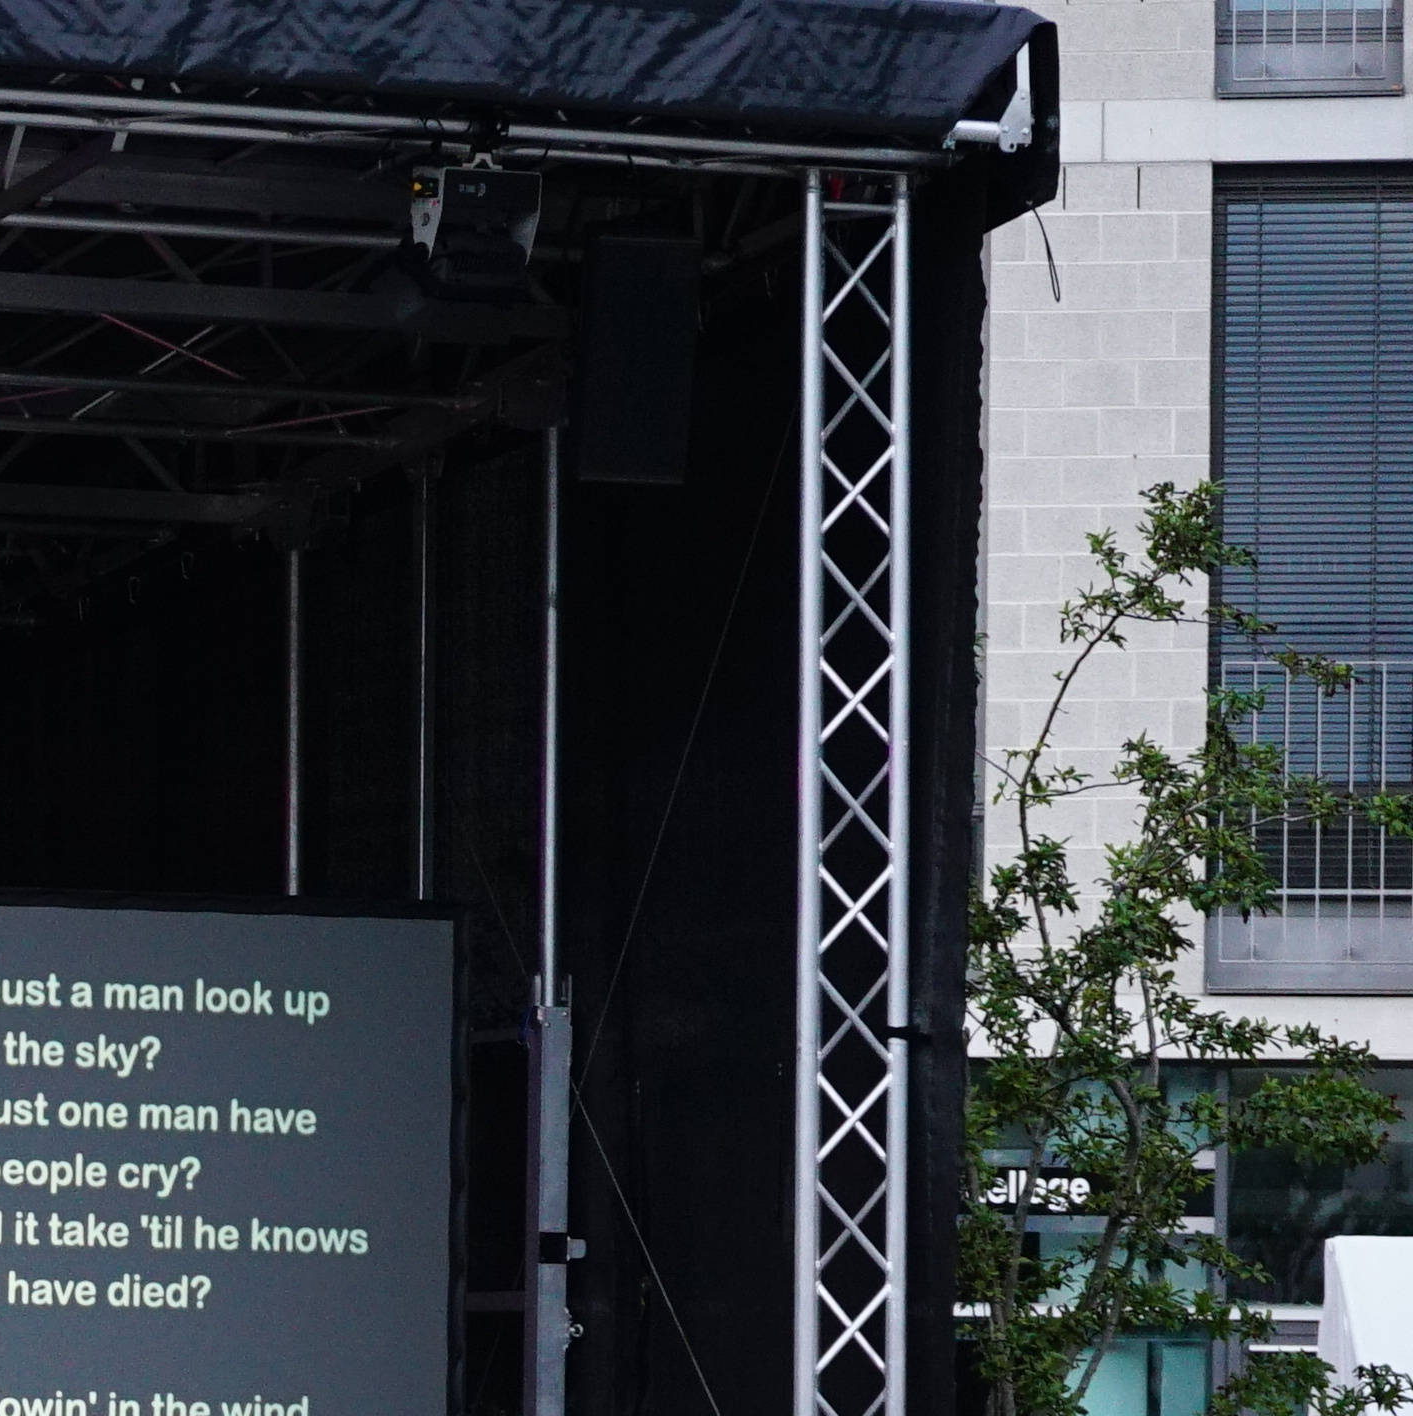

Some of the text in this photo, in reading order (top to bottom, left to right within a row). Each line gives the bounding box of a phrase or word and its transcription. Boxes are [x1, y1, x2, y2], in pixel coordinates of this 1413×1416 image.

[70, 981, 93, 1008] a
[103, 982, 184, 1012] man
[195, 977, 274, 1015] look
[284, 989, 330, 1025] up
[3, 1030, 65, 1067] the
[75, 1033, 162, 1078] sky?
[58, 1100, 129, 1129] one
[139, 1103, 219, 1132] man
[230, 1098, 317, 1135] have
[117, 1155, 201, 1198] cry?
[14, 1210, 40, 1246] it
[47, 1212, 130, 1248] take
[140, 1214, 183, 1249] 'til
[194, 1215, 240, 1251] he
[250, 1217, 369, 1255] knows
[7, 1270, 97, 1307] have
[107, 1273, 212, 1310] died?
